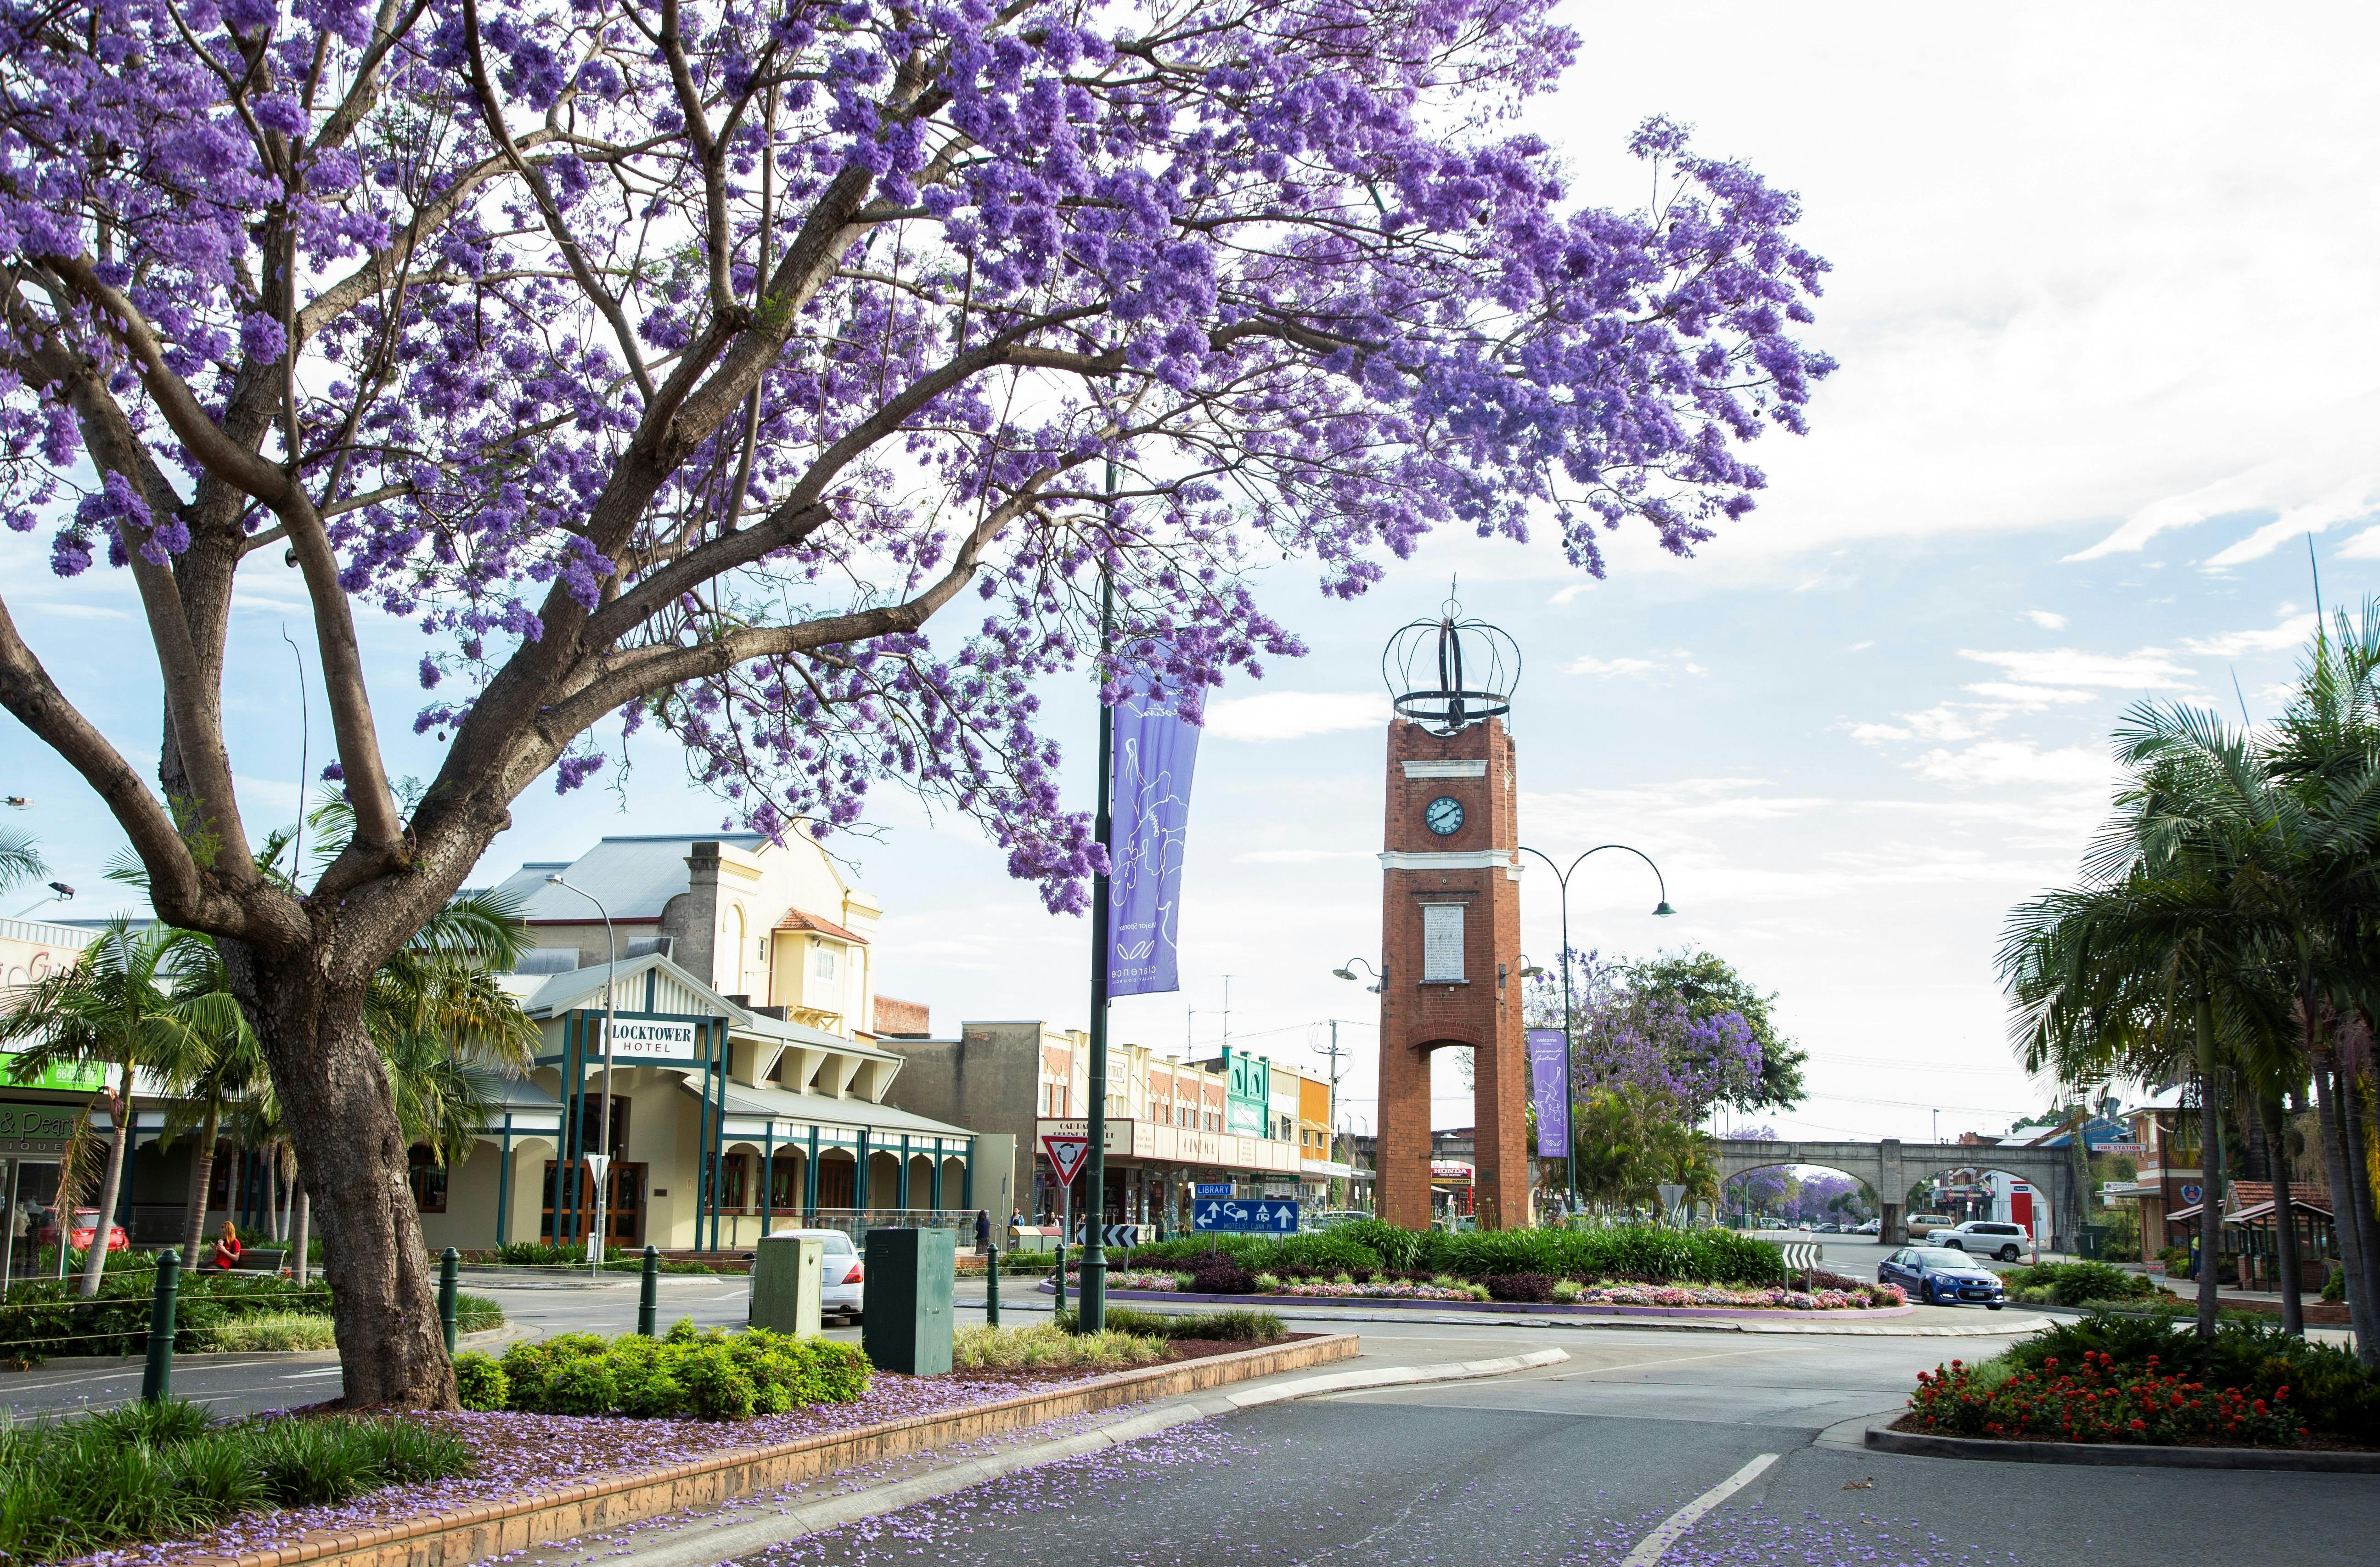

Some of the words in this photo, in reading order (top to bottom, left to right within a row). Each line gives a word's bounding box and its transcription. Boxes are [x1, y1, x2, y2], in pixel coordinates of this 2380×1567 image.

[604, 1025, 691, 1042] LOCKTOWER
[624, 1042, 670, 1052] HOTEL
[1535, 1054, 1560, 1065] festival
[0, 1141, 62, 1151] IQUE
[1184, 1137, 1214, 1154] CINEMA
[1198, 1185, 1229, 1194] LIBRARY
